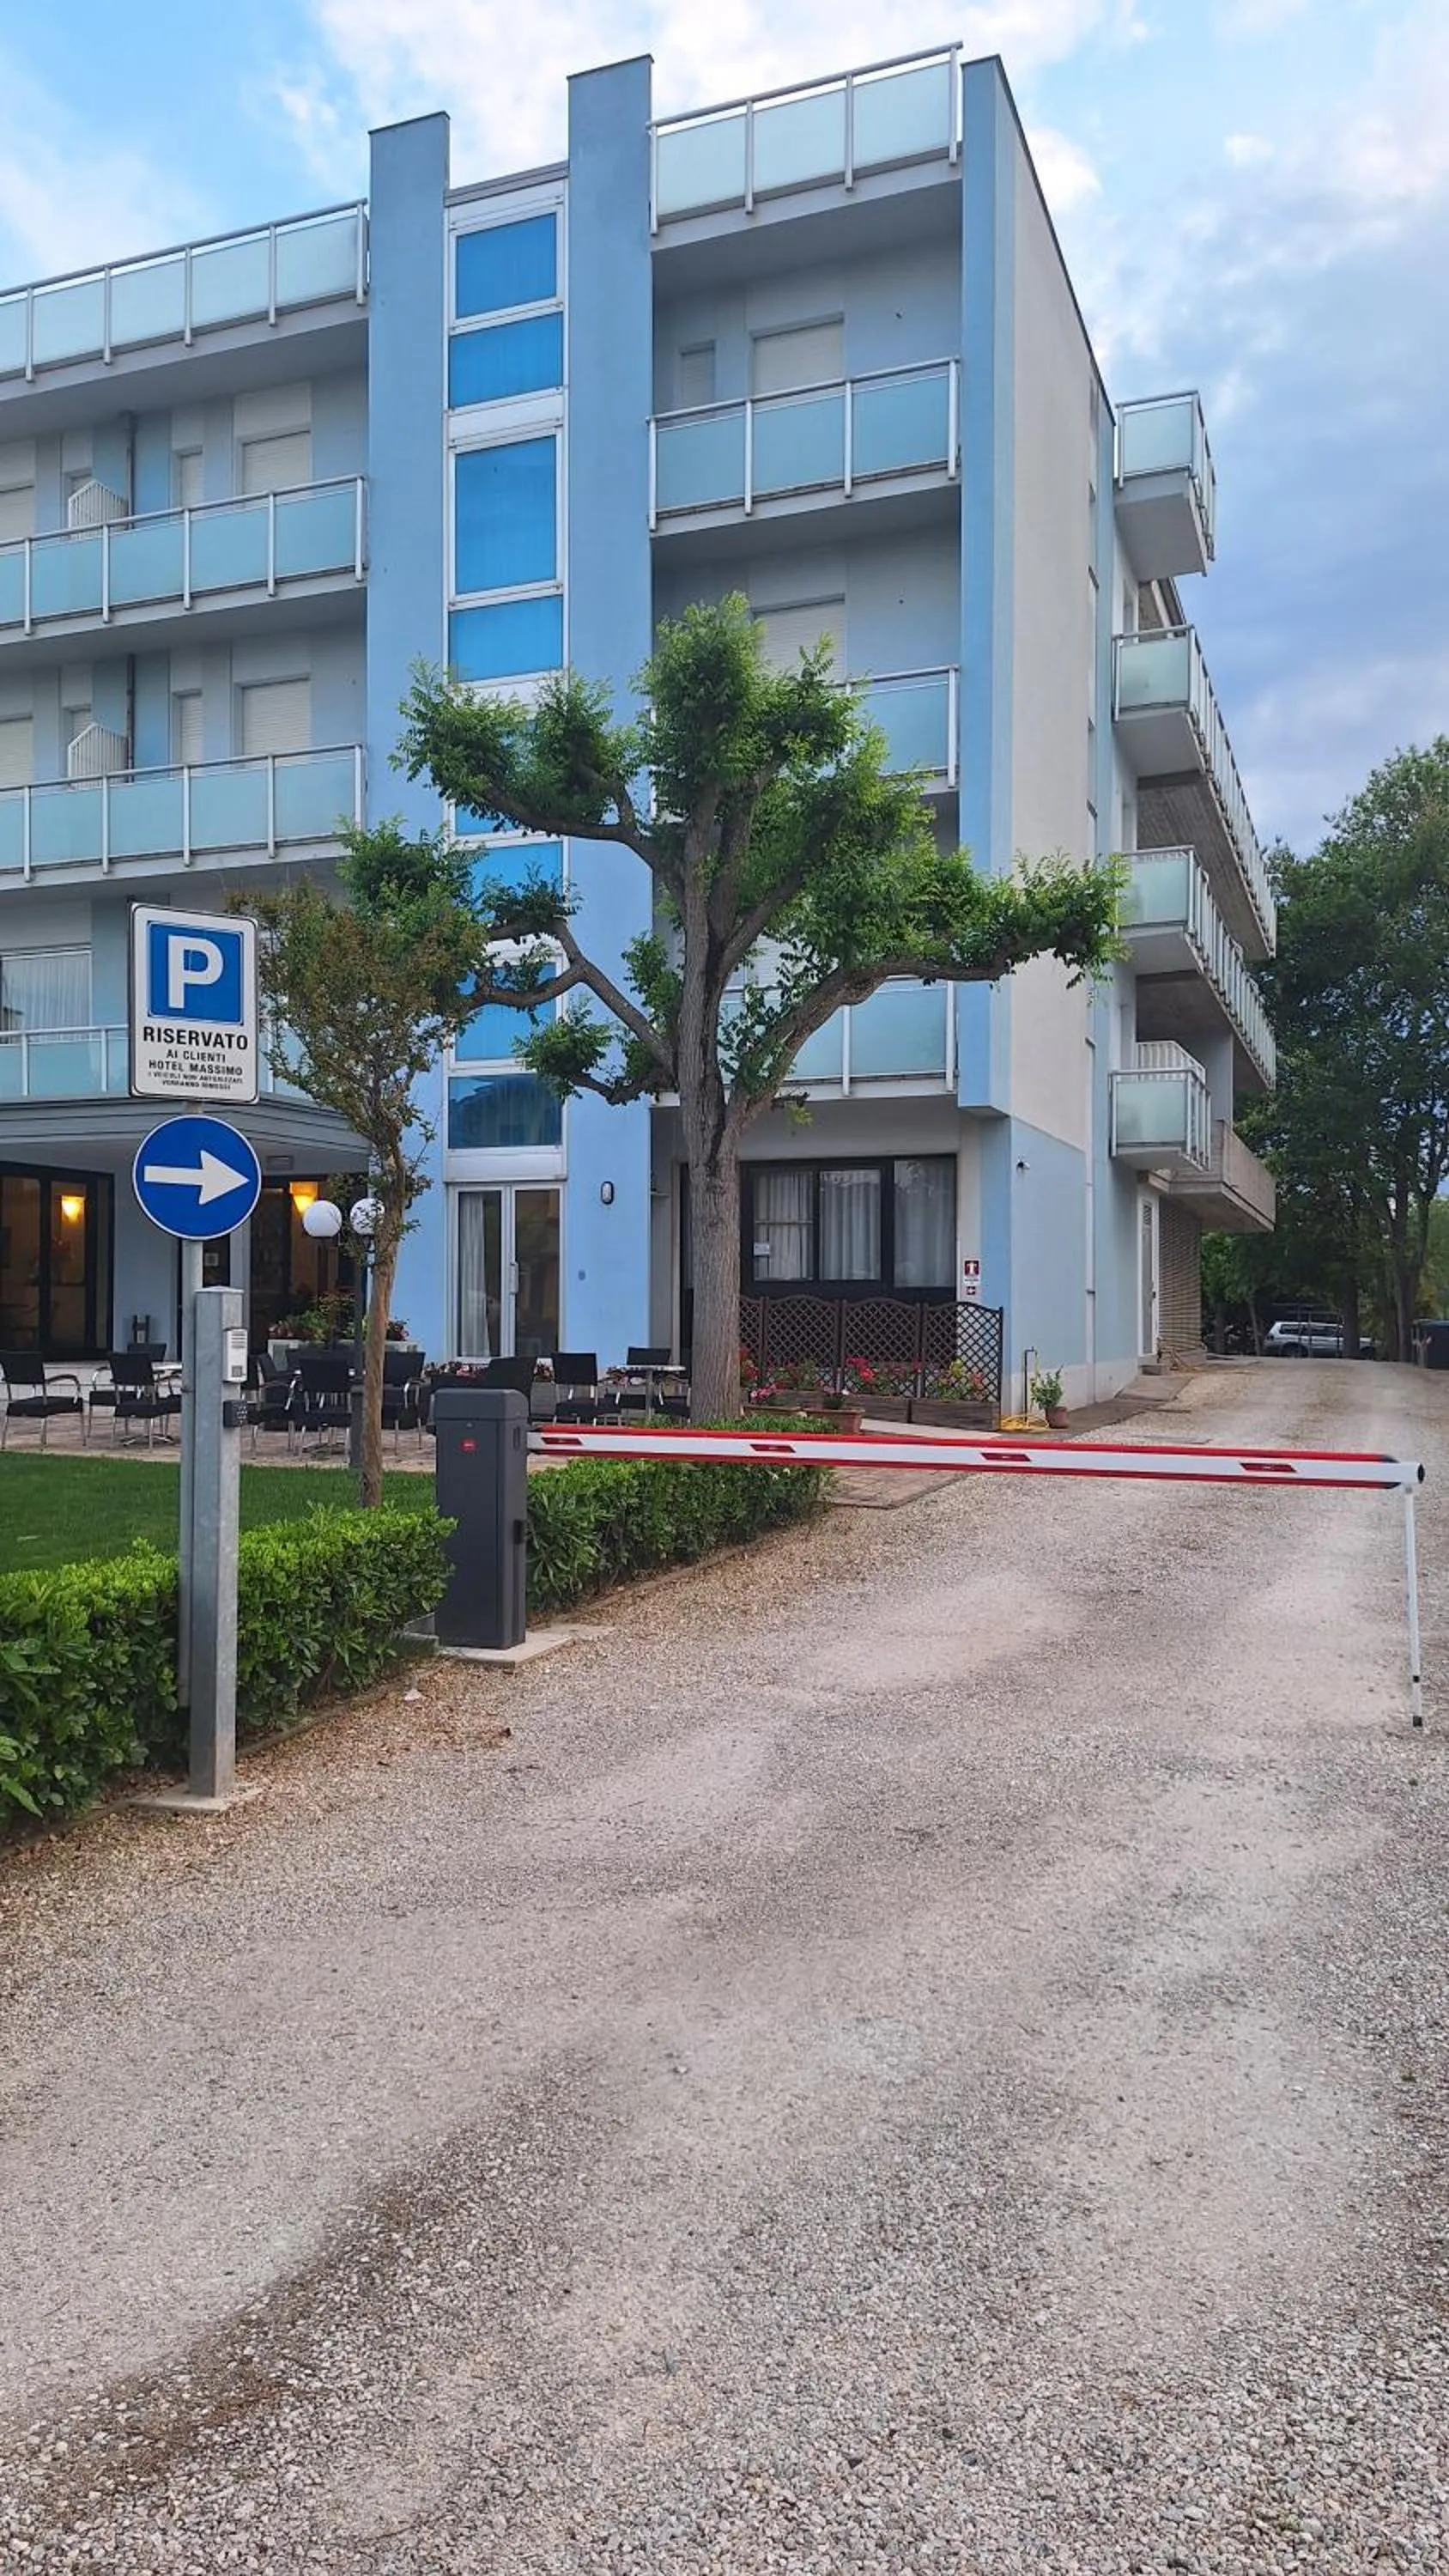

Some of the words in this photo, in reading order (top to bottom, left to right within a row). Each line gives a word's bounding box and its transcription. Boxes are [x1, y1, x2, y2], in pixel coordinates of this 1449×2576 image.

[168, 934, 224, 1009] P
[143, 1026, 248, 1050] RISERVATO
[167, 1049, 178, 1059] AI
[183, 1050, 226, 1063] CLIENTI
[149, 1060, 184, 1072] HOTEL
[190, 1063, 243, 1076] MASSIMO
